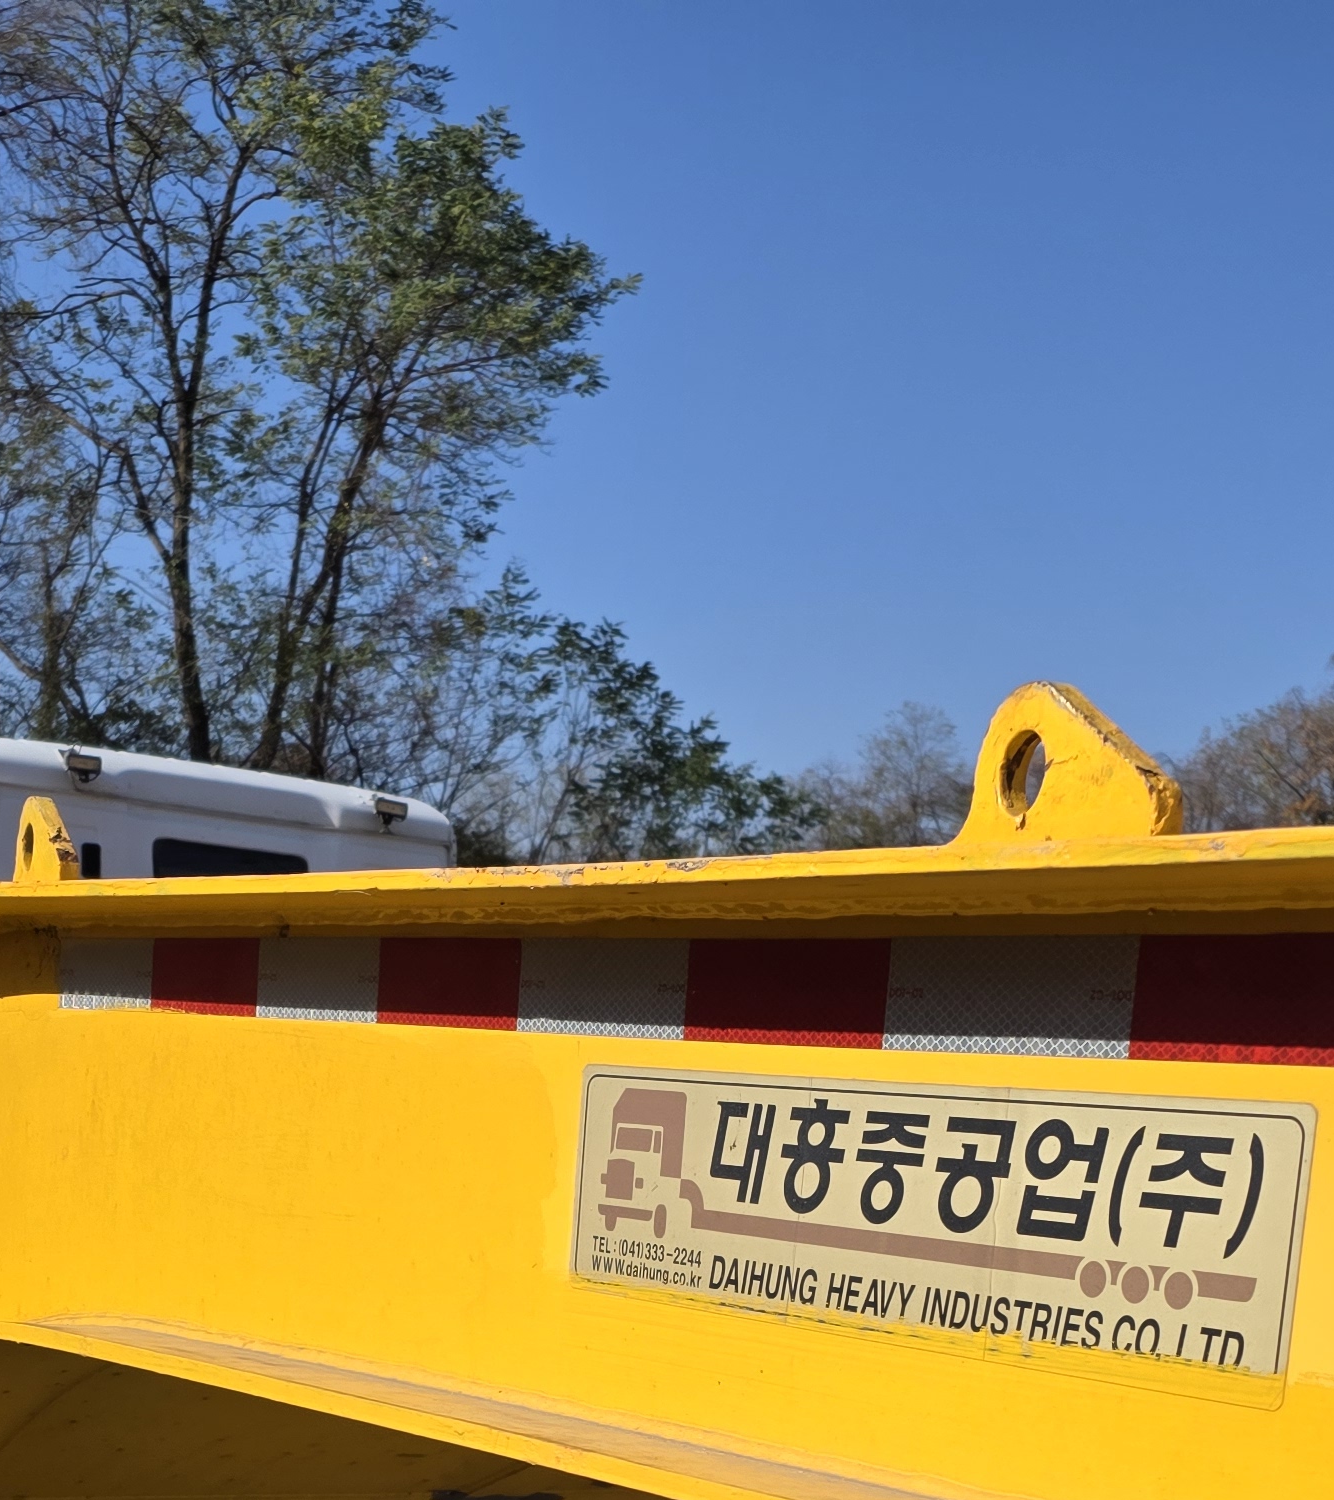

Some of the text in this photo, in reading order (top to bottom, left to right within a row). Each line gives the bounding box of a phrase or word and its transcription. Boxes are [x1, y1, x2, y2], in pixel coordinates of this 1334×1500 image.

[709, 1098, 1265, 1260] 대흥중공업(주)
[708, 1254, 818, 1306] DAIHUNG
[825, 1272, 916, 1320] HEAVY
[920, 1286, 1104, 1351] INDUSTRIES
